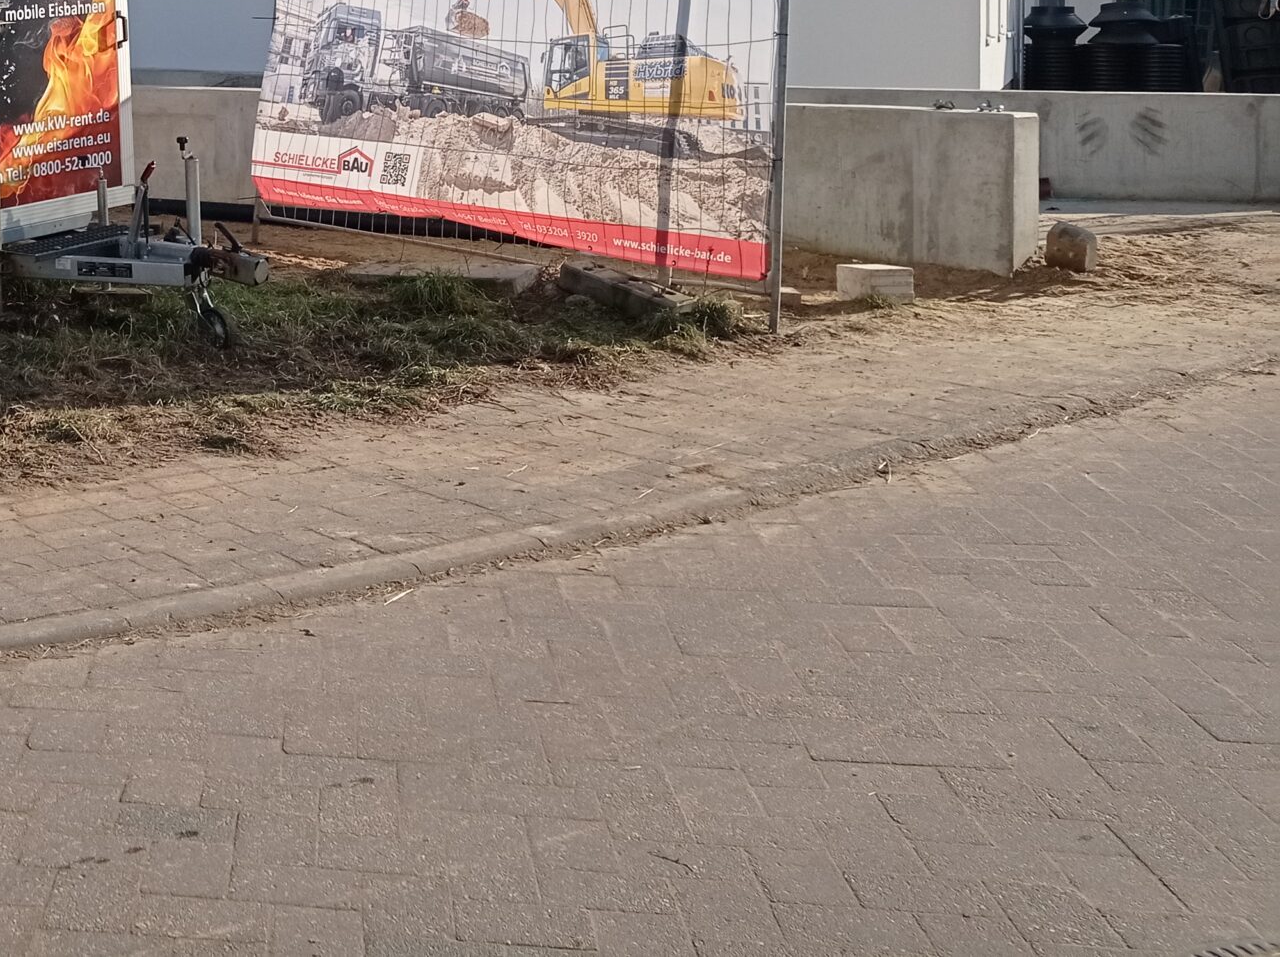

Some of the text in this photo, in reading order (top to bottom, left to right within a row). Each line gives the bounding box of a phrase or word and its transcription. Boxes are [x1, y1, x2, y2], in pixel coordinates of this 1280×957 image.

[5, 0, 106, 22] mobile Eisbahnen
[636, 63, 684, 80] Hybrid
[608, 86, 625, 94] 365
[13, 108, 110, 136] www.kW-rent.de
[12, 134, 111, 158] www.eisarena.eu
[33, 150, 112, 177] 0800-520000
[273, 151, 337, 169] SCHIELICKE
[342, 157, 369, 173] BAU
[536, 224, 568, 238] 033204
[576, 228, 598, 243] 3920
